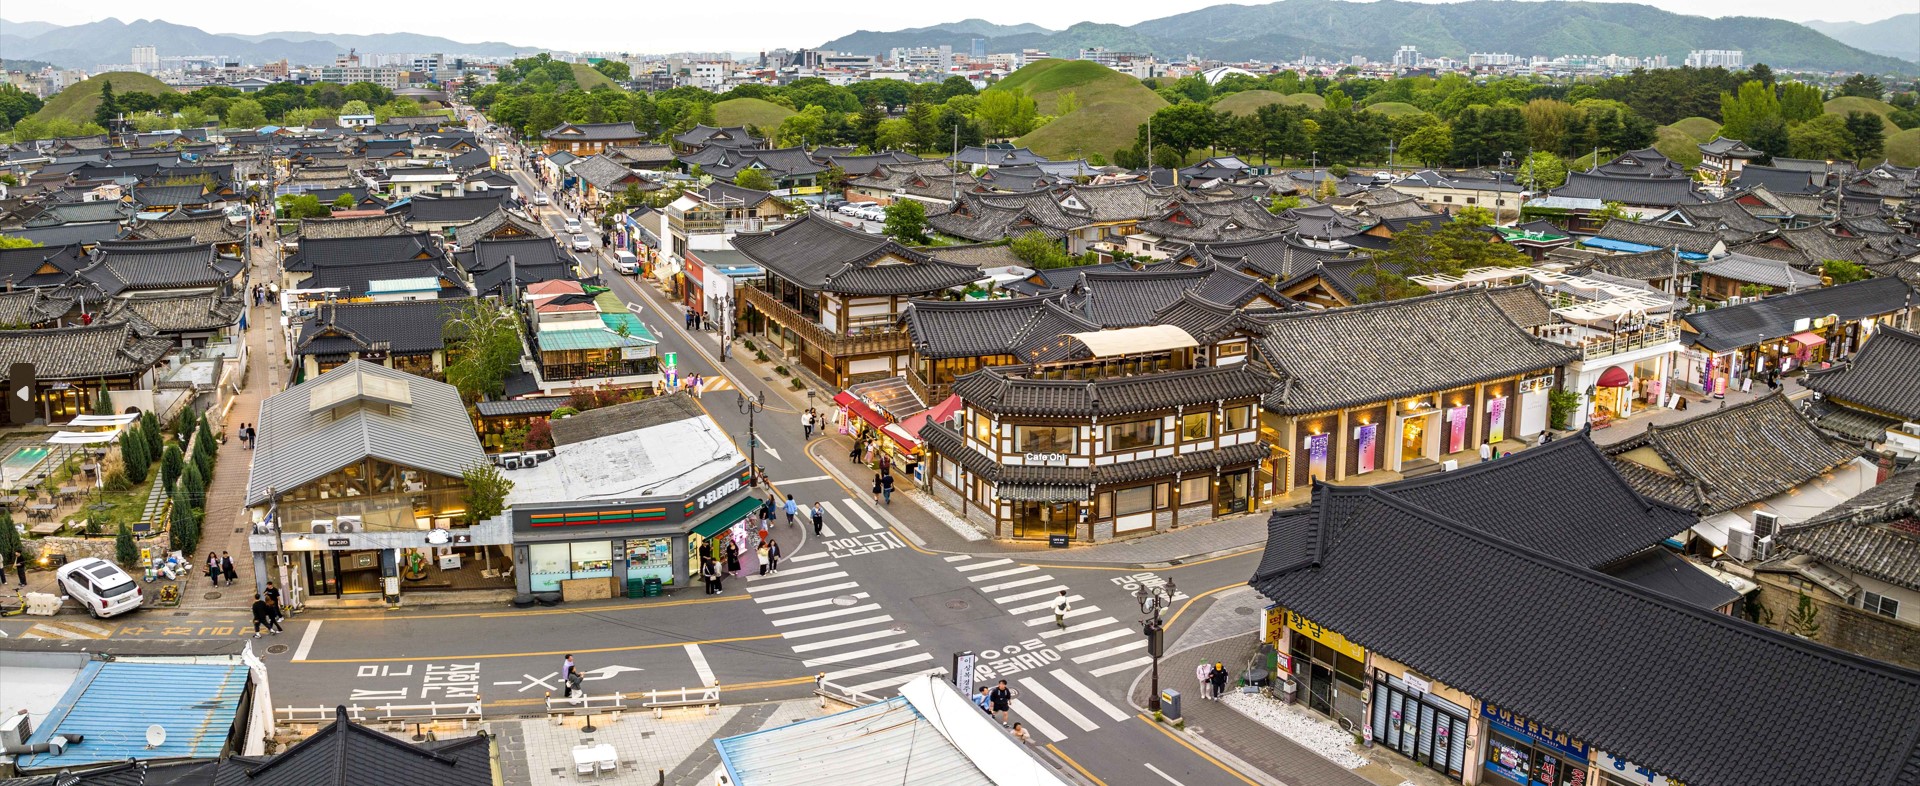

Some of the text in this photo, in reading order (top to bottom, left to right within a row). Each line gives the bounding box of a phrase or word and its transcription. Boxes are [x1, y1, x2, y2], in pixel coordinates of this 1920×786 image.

[1026, 453, 1047, 461] Cafe
[821, 531, 907, 559] 진입금지
[1268, 614, 1282, 641] 떡집
[1291, 613, 1323, 639] 황남
[350, 664, 413, 700] 금지
[421, 662, 480, 699] 좌회전
